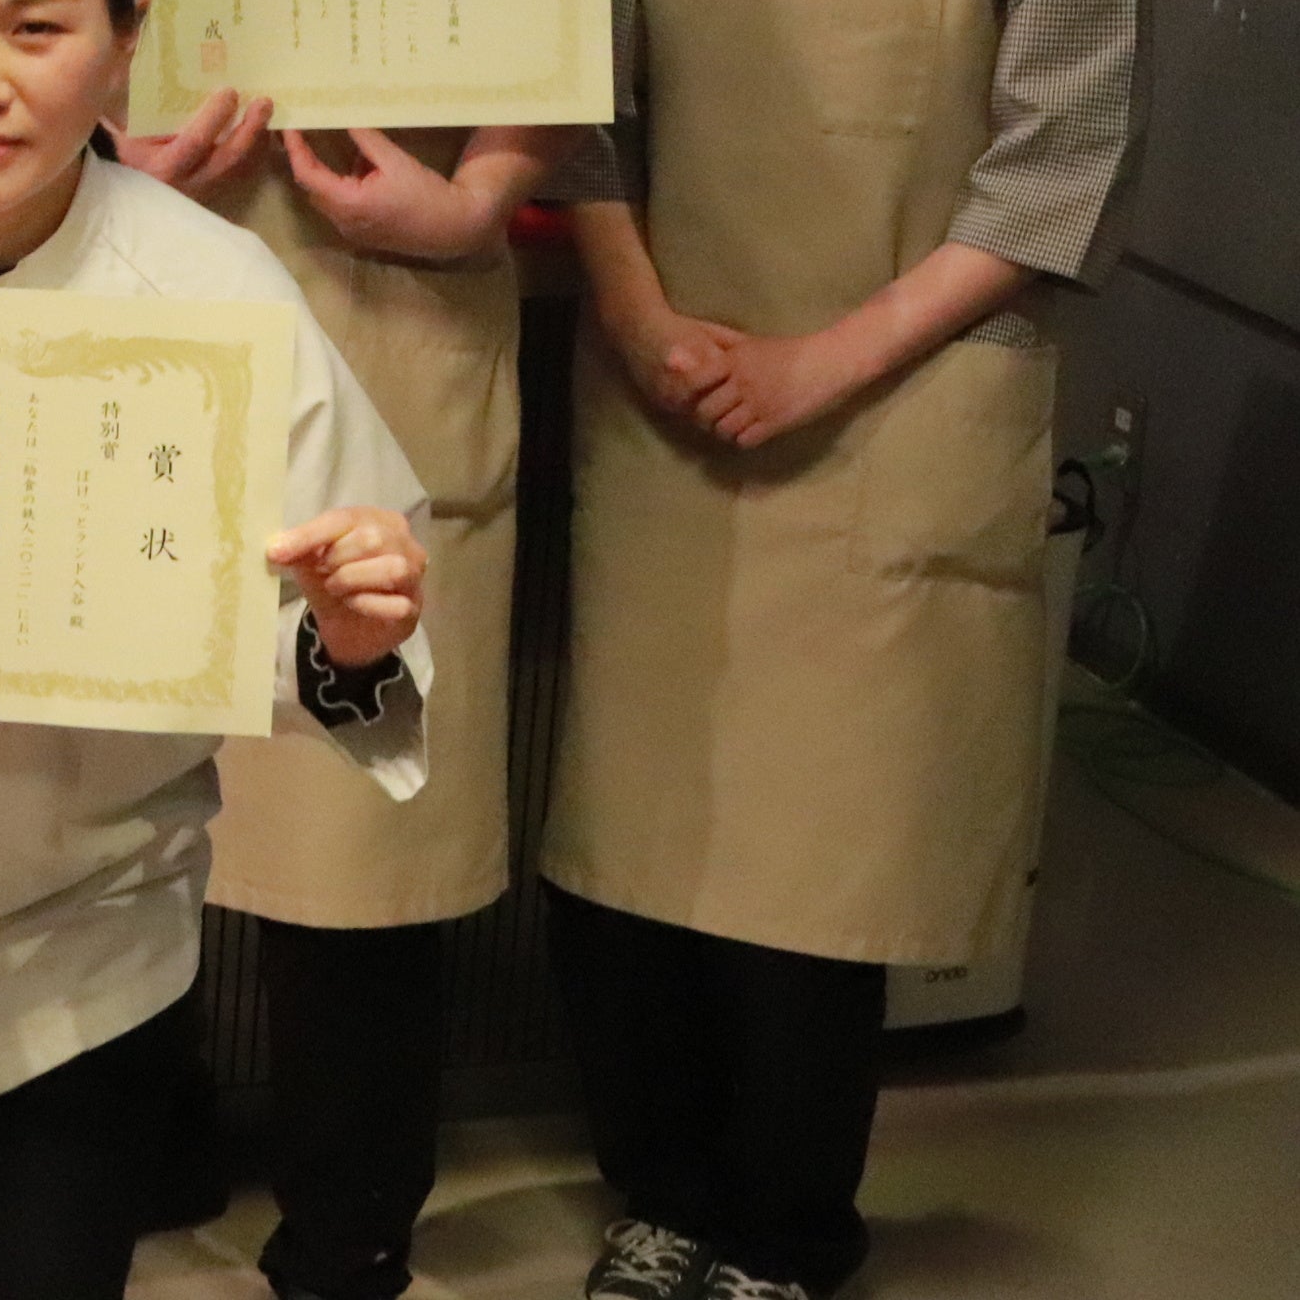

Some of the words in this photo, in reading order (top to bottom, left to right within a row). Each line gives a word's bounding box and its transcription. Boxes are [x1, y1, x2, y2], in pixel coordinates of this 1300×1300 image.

[101, 401, 120, 461] 特別賞
[140, 443, 181, 561] 賞状
